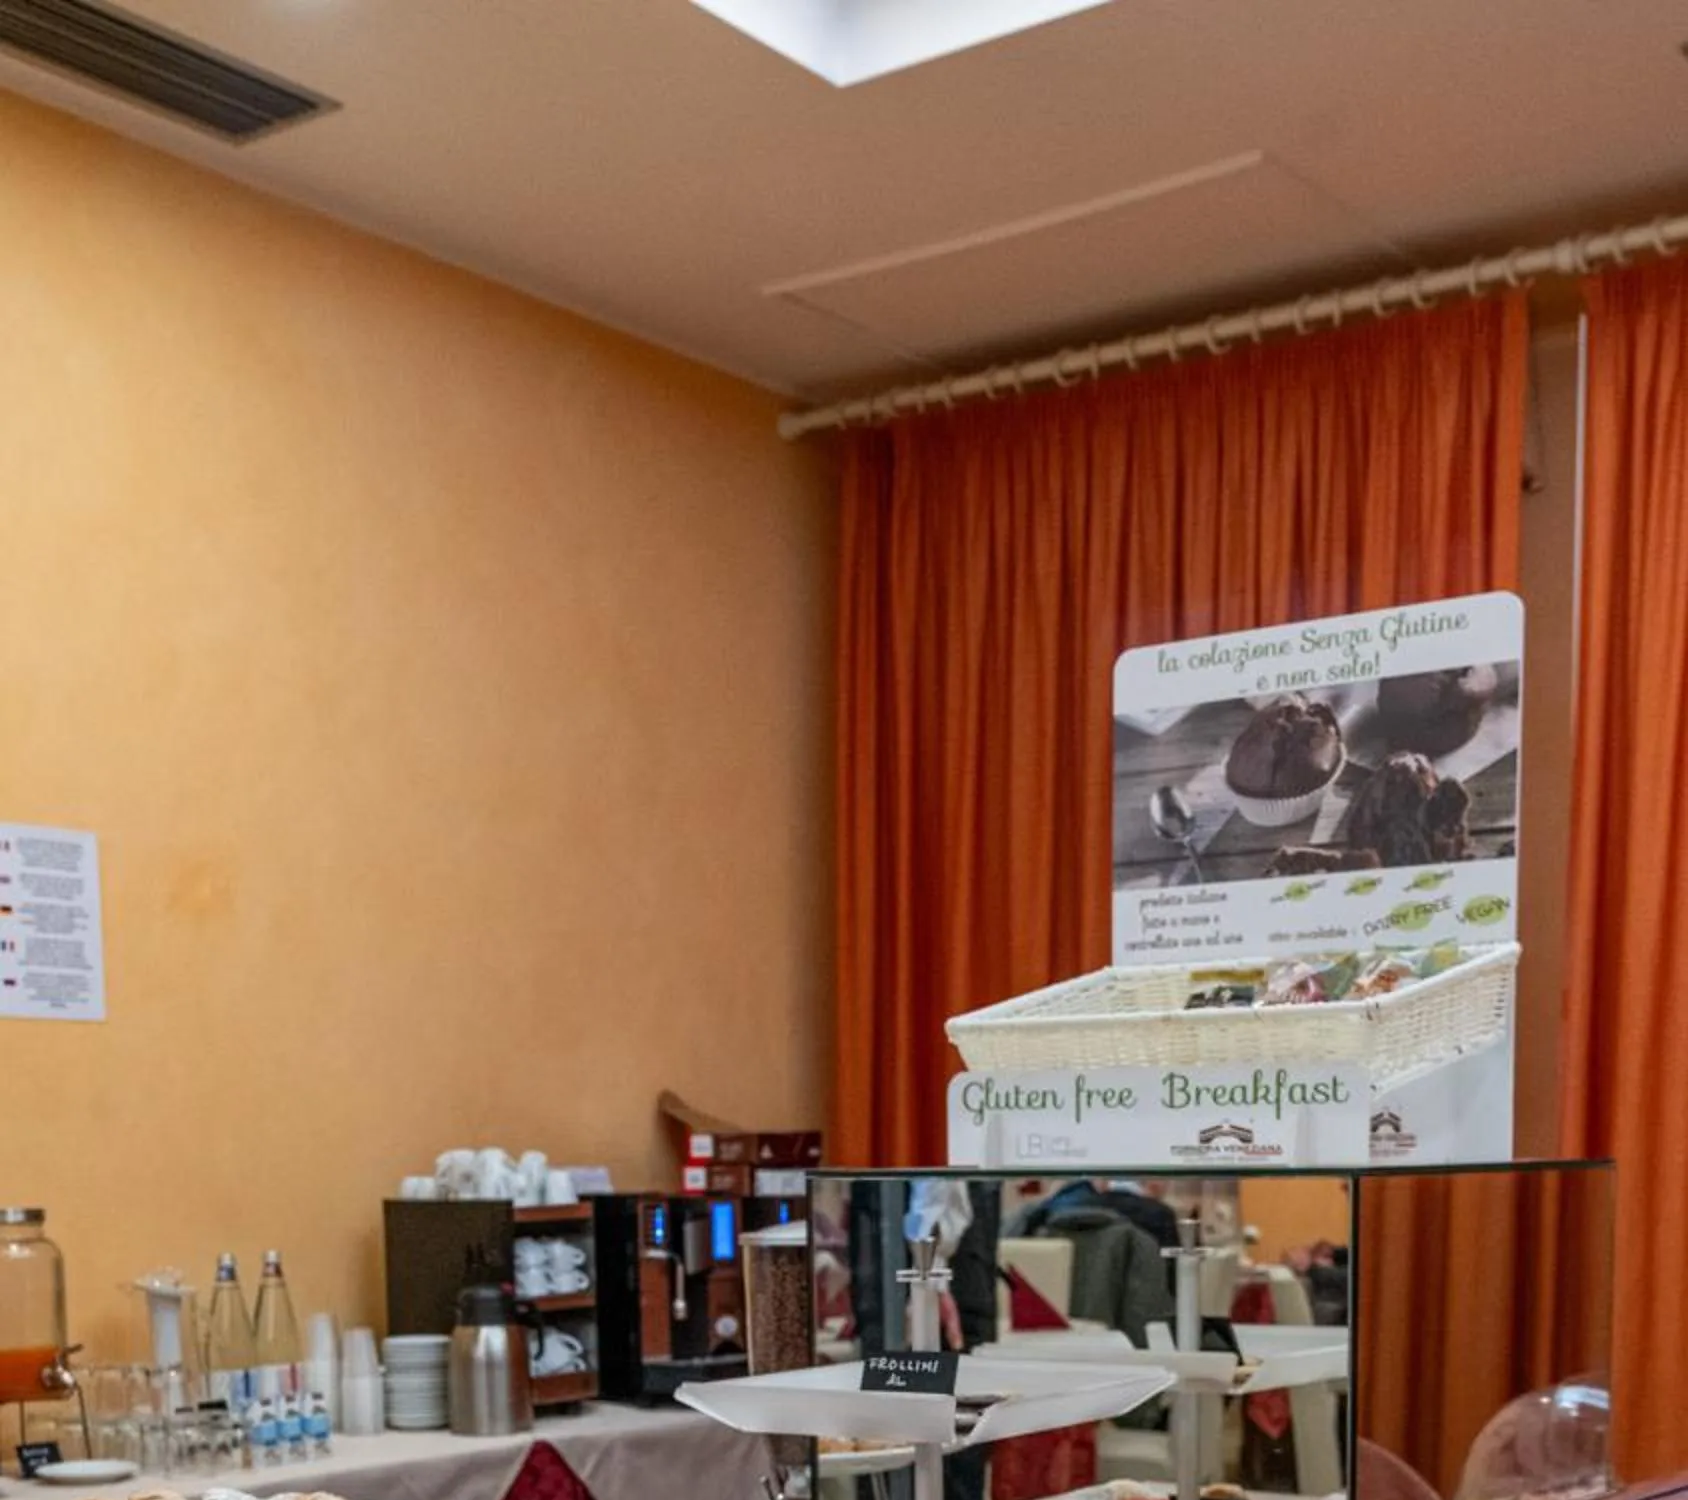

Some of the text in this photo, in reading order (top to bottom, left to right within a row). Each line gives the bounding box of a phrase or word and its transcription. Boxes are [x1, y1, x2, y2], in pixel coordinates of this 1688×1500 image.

[1188, 638, 1292, 672] colazione
[1300, 626, 1373, 657] Senza
[1380, 611, 1470, 652] Glutine
[1276, 666, 1320, 688] non
[1326, 652, 1380, 681] solo!
[1414, 896, 1453, 920] FREE
[1455, 897, 1511, 924] VEGAN
[961, 1070, 1350, 1125] Gluten free Breakfast
